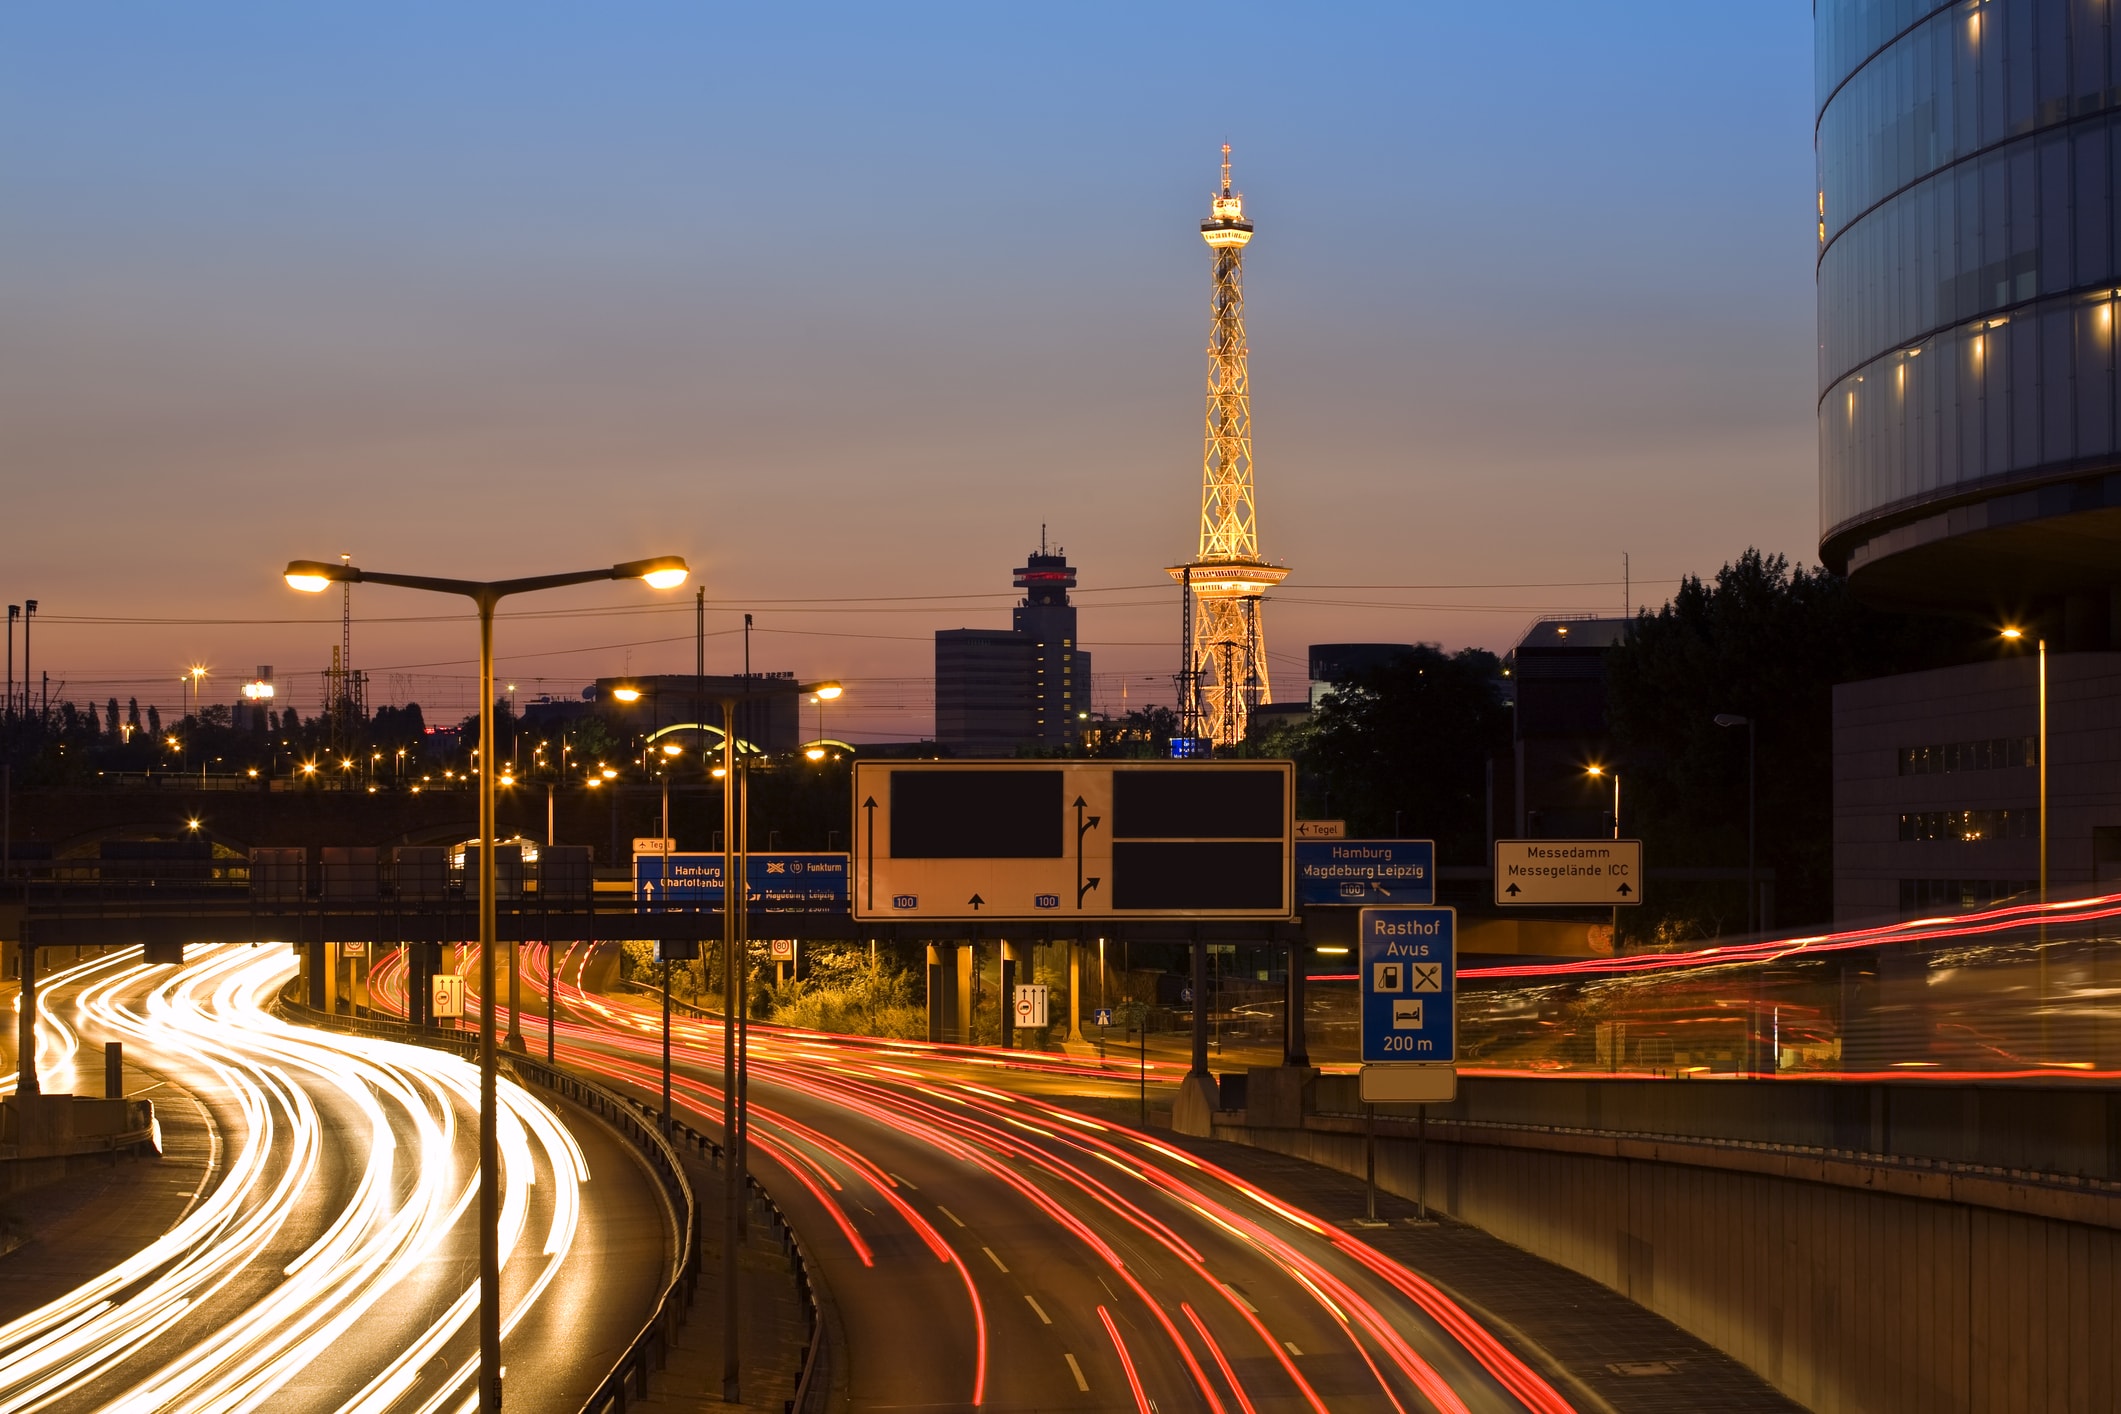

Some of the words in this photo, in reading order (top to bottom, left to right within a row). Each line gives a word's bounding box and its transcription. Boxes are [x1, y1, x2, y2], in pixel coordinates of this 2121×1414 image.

[1313, 825, 1338, 835] Tegel
[650, 841, 670, 849] Tegl
[1332, 847, 1392, 861] Hamburg
[1527, 847, 1610, 858] Messedamm
[675, 866, 720, 877] Hamburg
[807, 863, 842, 872] Funkturm
[1303, 864, 1374, 879] Magdeburg
[1377, 864, 1424, 879] Leipzig
[1508, 864, 1602, 878] Messegelände
[1608, 864, 1629, 876] ICC
[660, 878, 734, 889] Charlottenbu
[1345, 884, 1361, 895] 100
[897, 897, 914, 907] 100
[1039, 896, 1056, 906] 100
[1375, 920, 1440, 935] Rasthof
[777, 941, 786, 950] 80
[1387, 941, 1429, 956] Avus
[1383, 1036, 1413, 1051] 200
[1417, 1039, 1433, 1051] m
